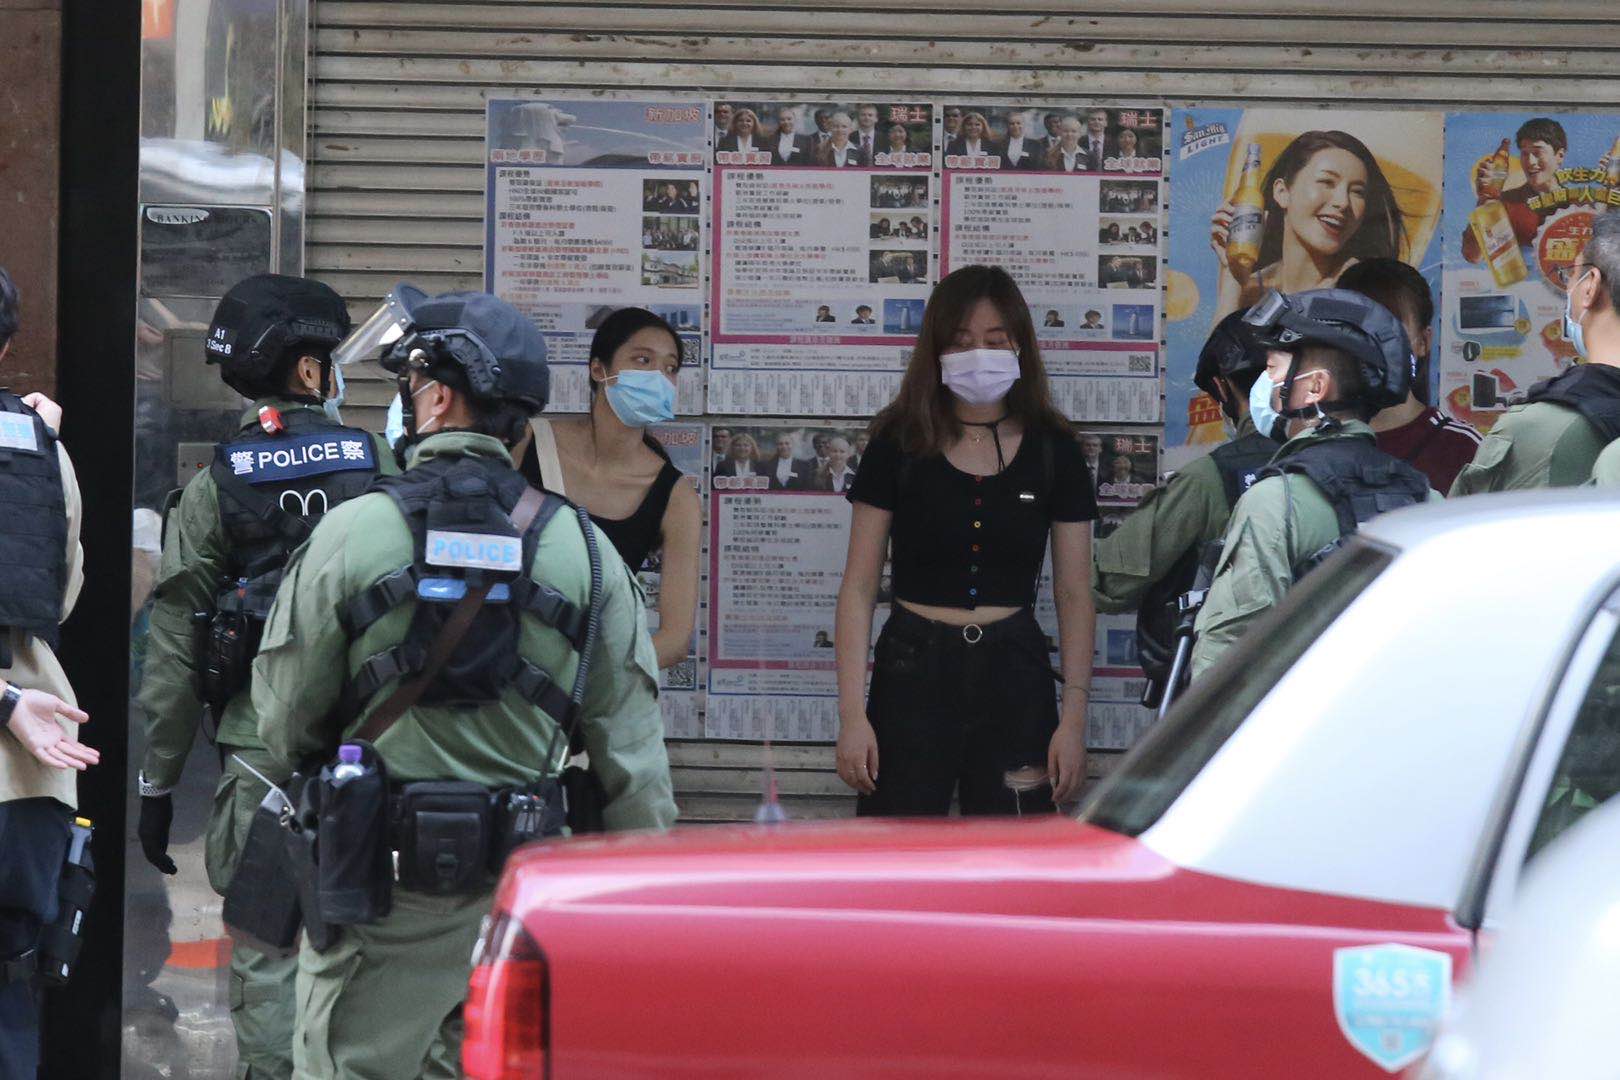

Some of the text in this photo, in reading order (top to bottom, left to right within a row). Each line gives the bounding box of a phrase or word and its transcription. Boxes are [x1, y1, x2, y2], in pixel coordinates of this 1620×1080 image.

[889, 107, 926, 122] 瑞士
[1119, 111, 1156, 128] 瑞士
[1187, 135, 1224, 153] LIGHT
[230, 450, 255, 475] 警
[258, 442, 340, 469] POLICE
[434, 538, 515, 564] POLICE
